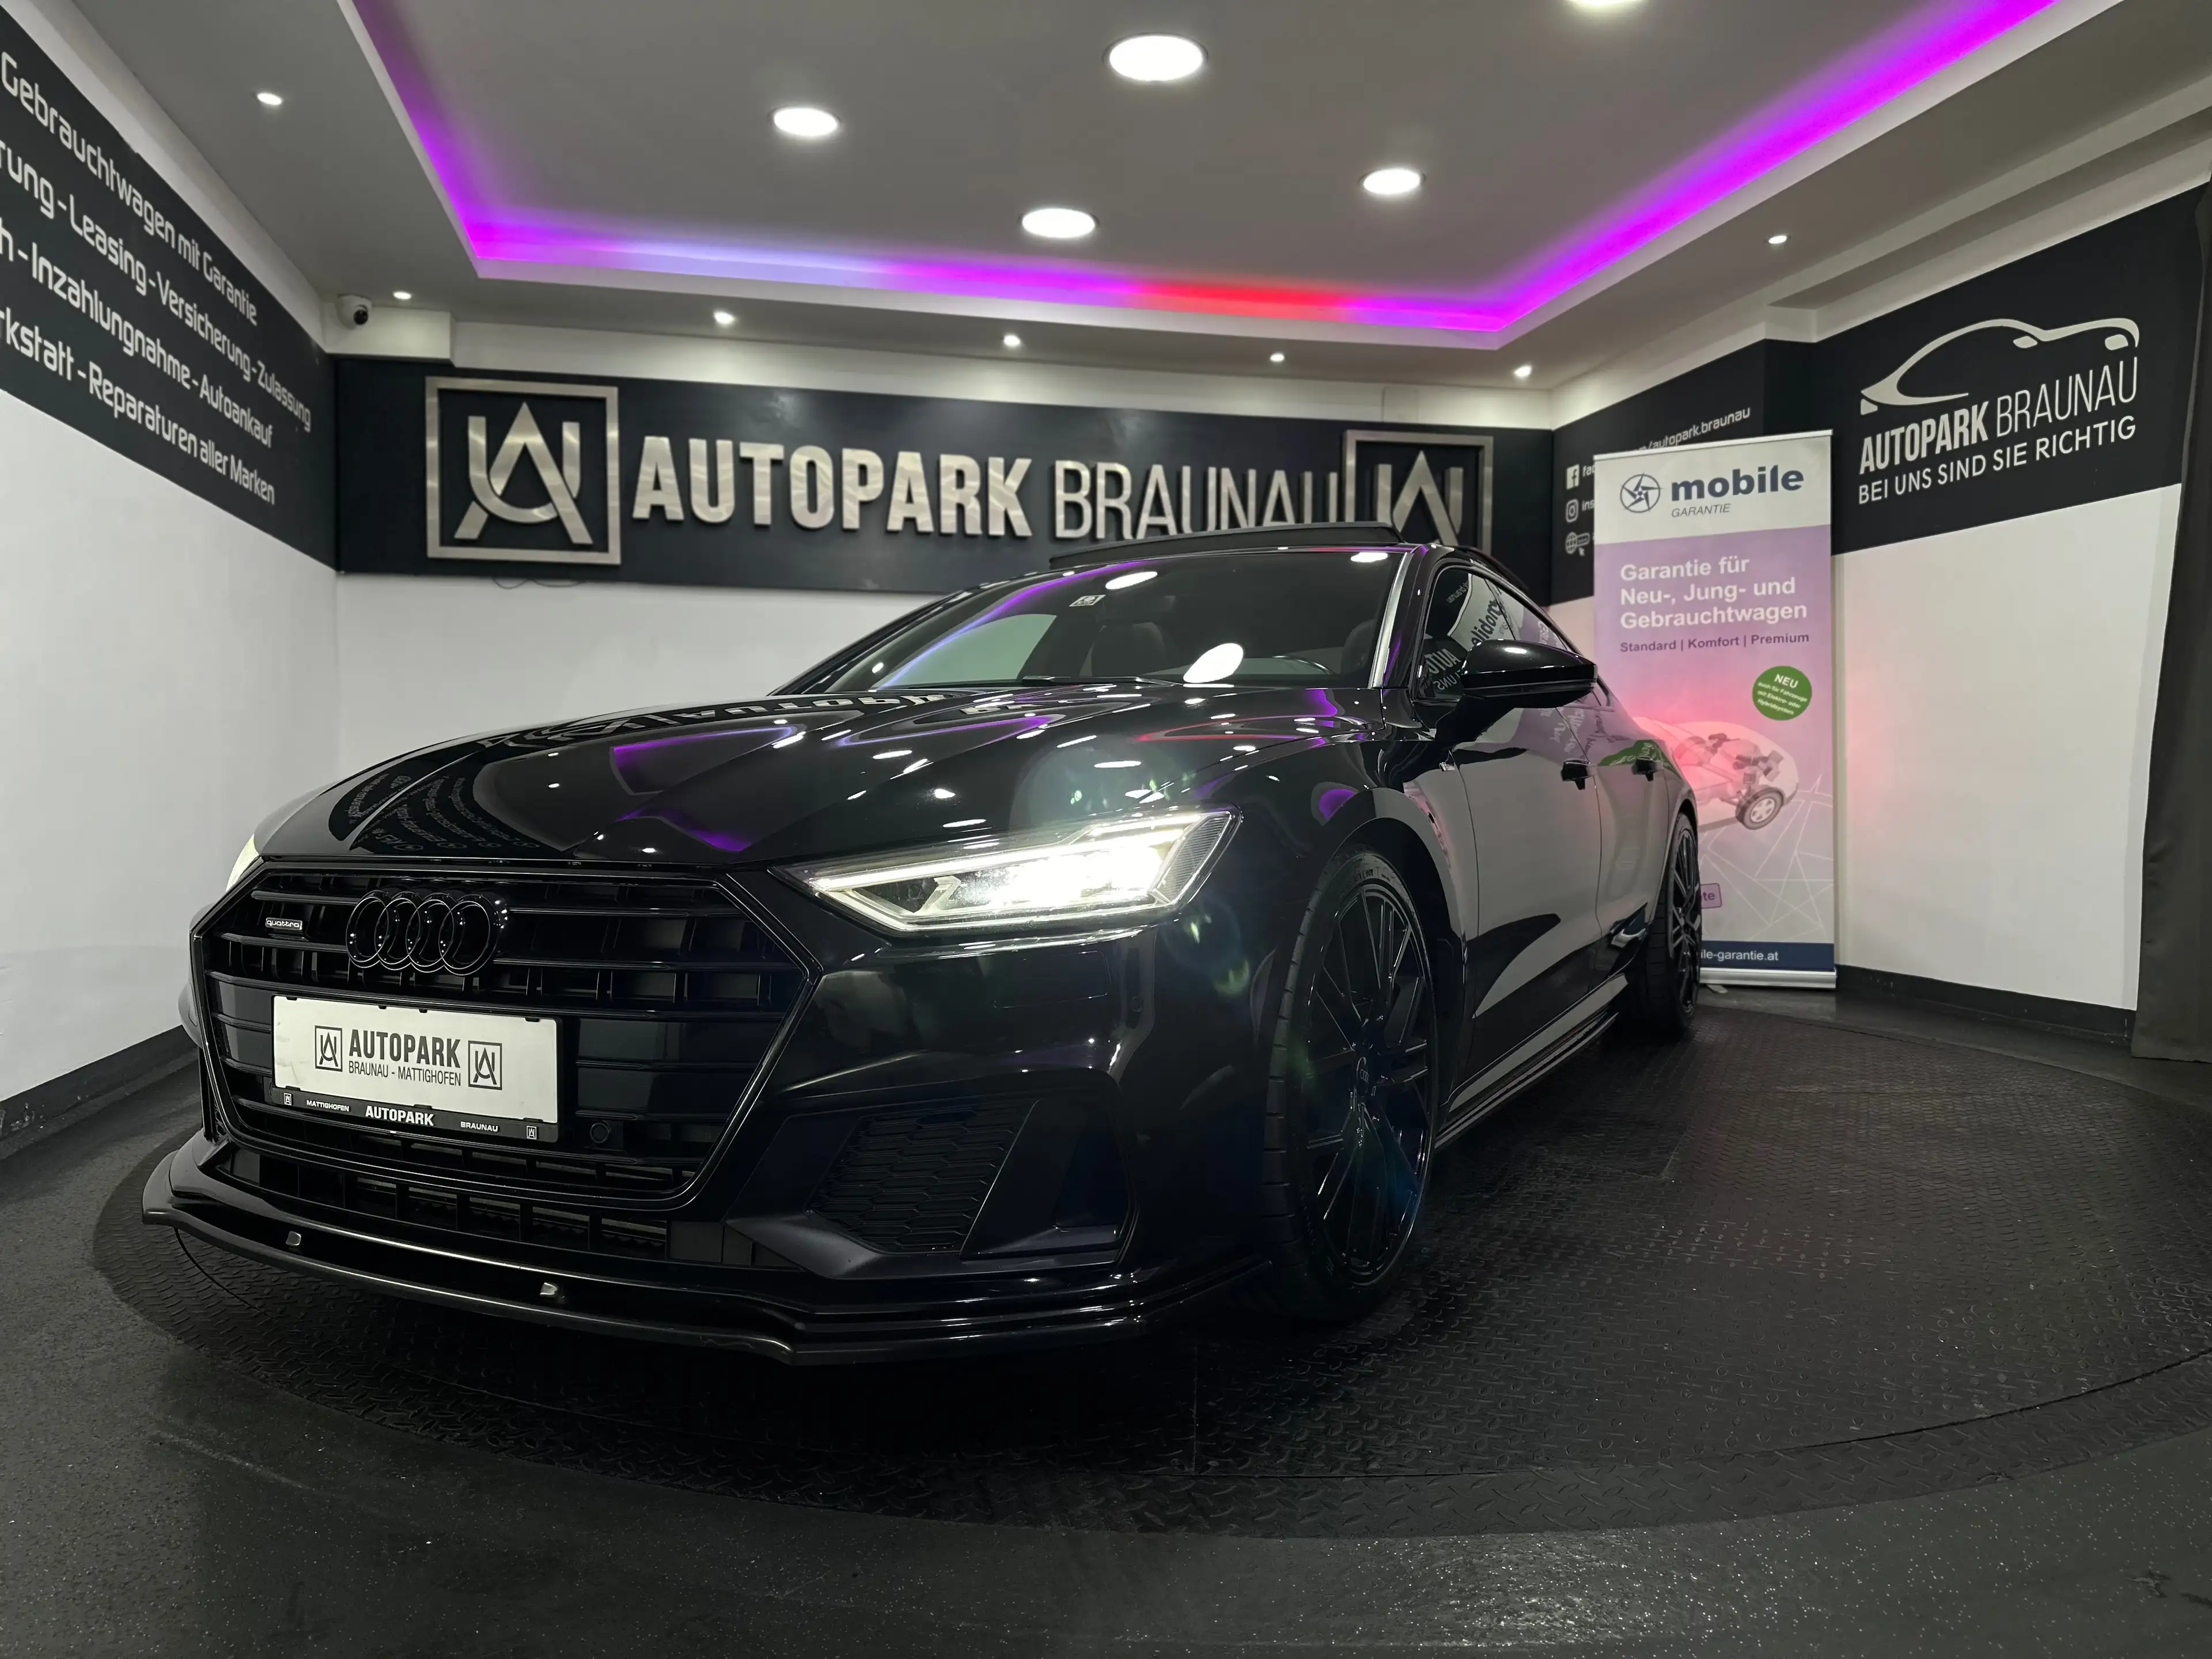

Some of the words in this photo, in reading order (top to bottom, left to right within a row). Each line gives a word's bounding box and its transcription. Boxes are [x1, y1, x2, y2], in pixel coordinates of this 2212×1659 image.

[2, 52, 175, 249] Gebrauchtwagen
[178, 233, 200, 271] mit
[202, 251, 257, 326] Garantie
[1859, 402, 1988, 474] AUTOPARK
[1996, 357, 2138, 438] BRAUNAU
[199, 440, 228, 475] aller
[230, 454, 275, 505] Marken
[1859, 479, 1888, 504] BEI
[1895, 468, 1932, 495] UNS
[1938, 454, 1986, 486] SIND
[1993, 442, 2027, 471] SIE
[2036, 415, 2136, 460] RICHTIG
[632, 435, 1032, 539] AUTOPARK
[1054, 460, 1338, 540] BRAUNAU
[1672, 465, 1804, 501] mobile
[1672, 503, 1732, 518] GARANTIE
[1620, 559, 1711, 581] Garantie
[1719, 556, 1750, 575] für
[1620, 588, 1676, 606] Neu-,
[1683, 584, 1747, 603] Jung-
[1753, 577, 1796, 596] und
[1620, 603, 1808, 629] Gebrauchtwagen
[1620, 640, 1676, 652] Standard
[1688, 635, 1740, 649] Komfort
[1751, 632, 1809, 645] Premium
[1774, 673, 1798, 688] NEU
[267, 920, 300, 928] quattro
[349, 1029, 461, 1069] AUTOPARK
[349, 1060, 389, 1078] BRAUNAU
[398, 1067, 461, 1086] MATTIGHOFEN
[306, 1100, 350, 1112] MATTIGHOFEN
[365, 1105, 434, 1126] AUTOPARK
[460, 1121, 498, 1132] BRAUNAU
